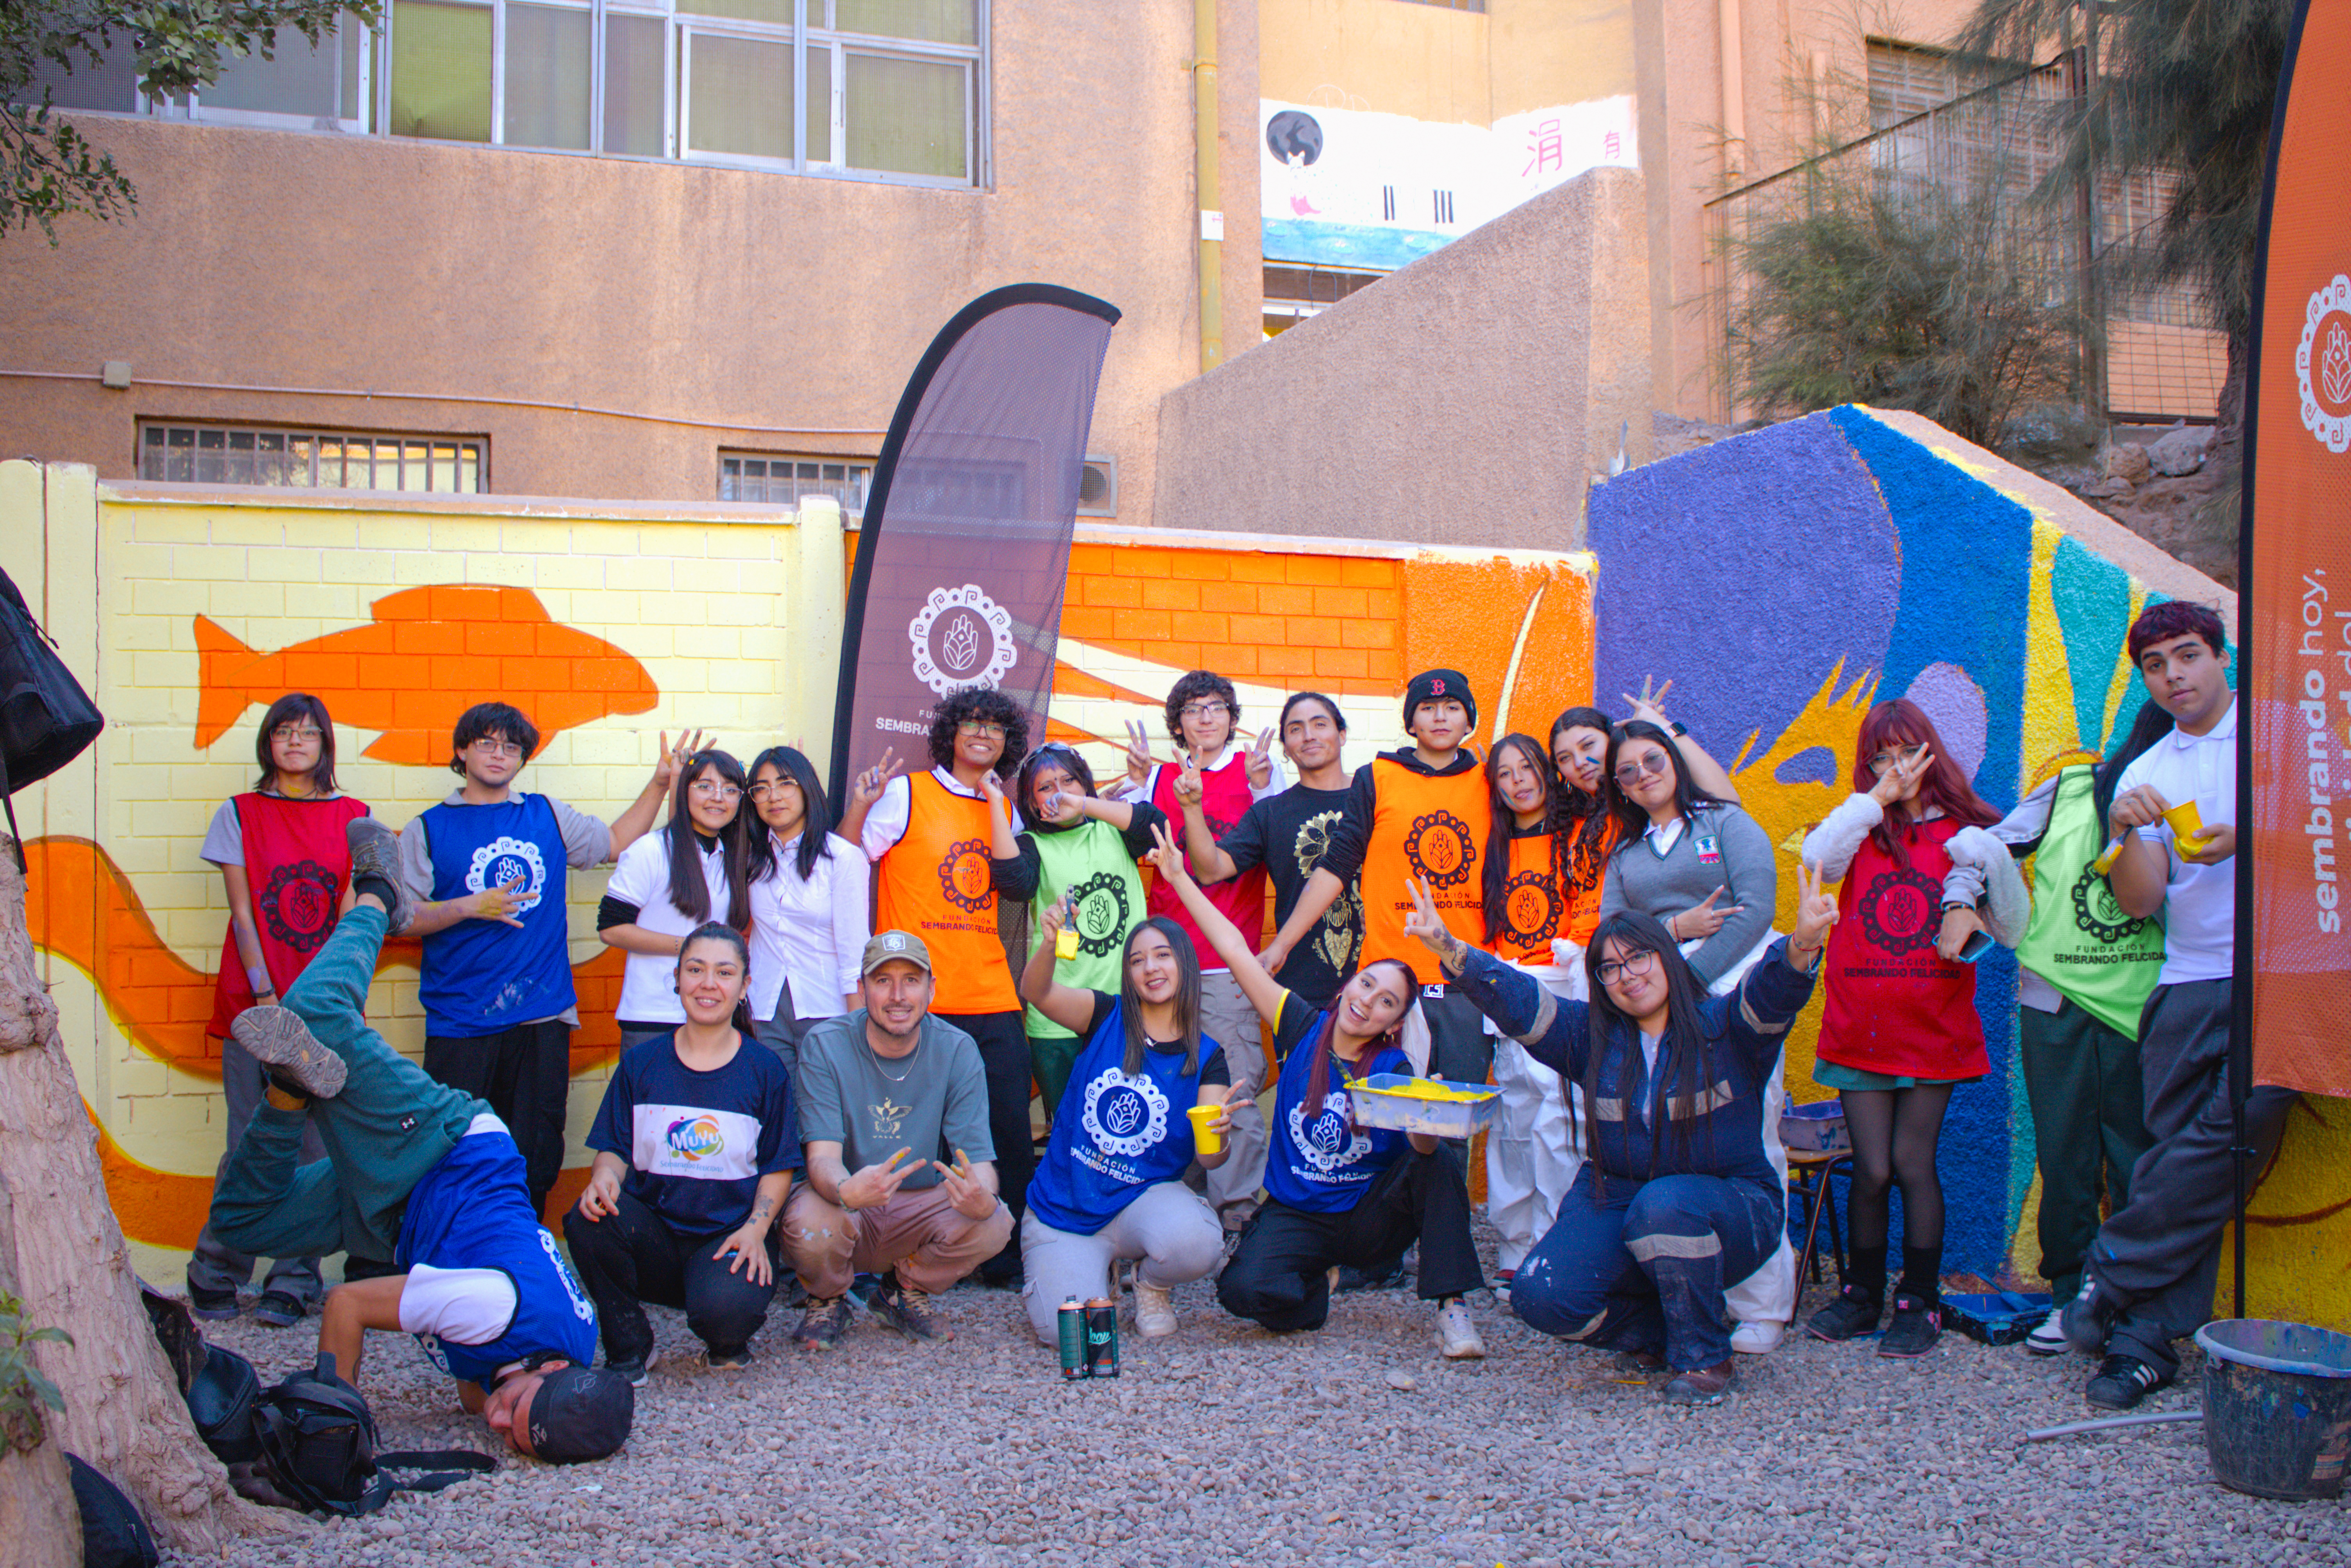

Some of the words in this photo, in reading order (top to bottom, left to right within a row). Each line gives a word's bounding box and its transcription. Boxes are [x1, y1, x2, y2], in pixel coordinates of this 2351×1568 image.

[2298, 569, 2328, 656] hoy,
[1430, 679, 1445, 696] B
[875, 717, 934, 737] SEMBRA
[2299, 669, 2340, 934] sembrando
[1395, 901, 1452, 910] SEMNDO
[921, 921, 974, 931] SEMBRANDO
[2076, 943, 2145, 953] FUNDACIÓN
[1866, 957, 1936, 967] FUNDACIÓN
[2054, 953, 2119, 964] SEMBRANDO
[1844, 967, 1907, 978] SEMBRANDO
[1910, 968, 1961, 979] FELICIDAD
[1081, 1144, 1136, 1175] FUNDACIÓN
